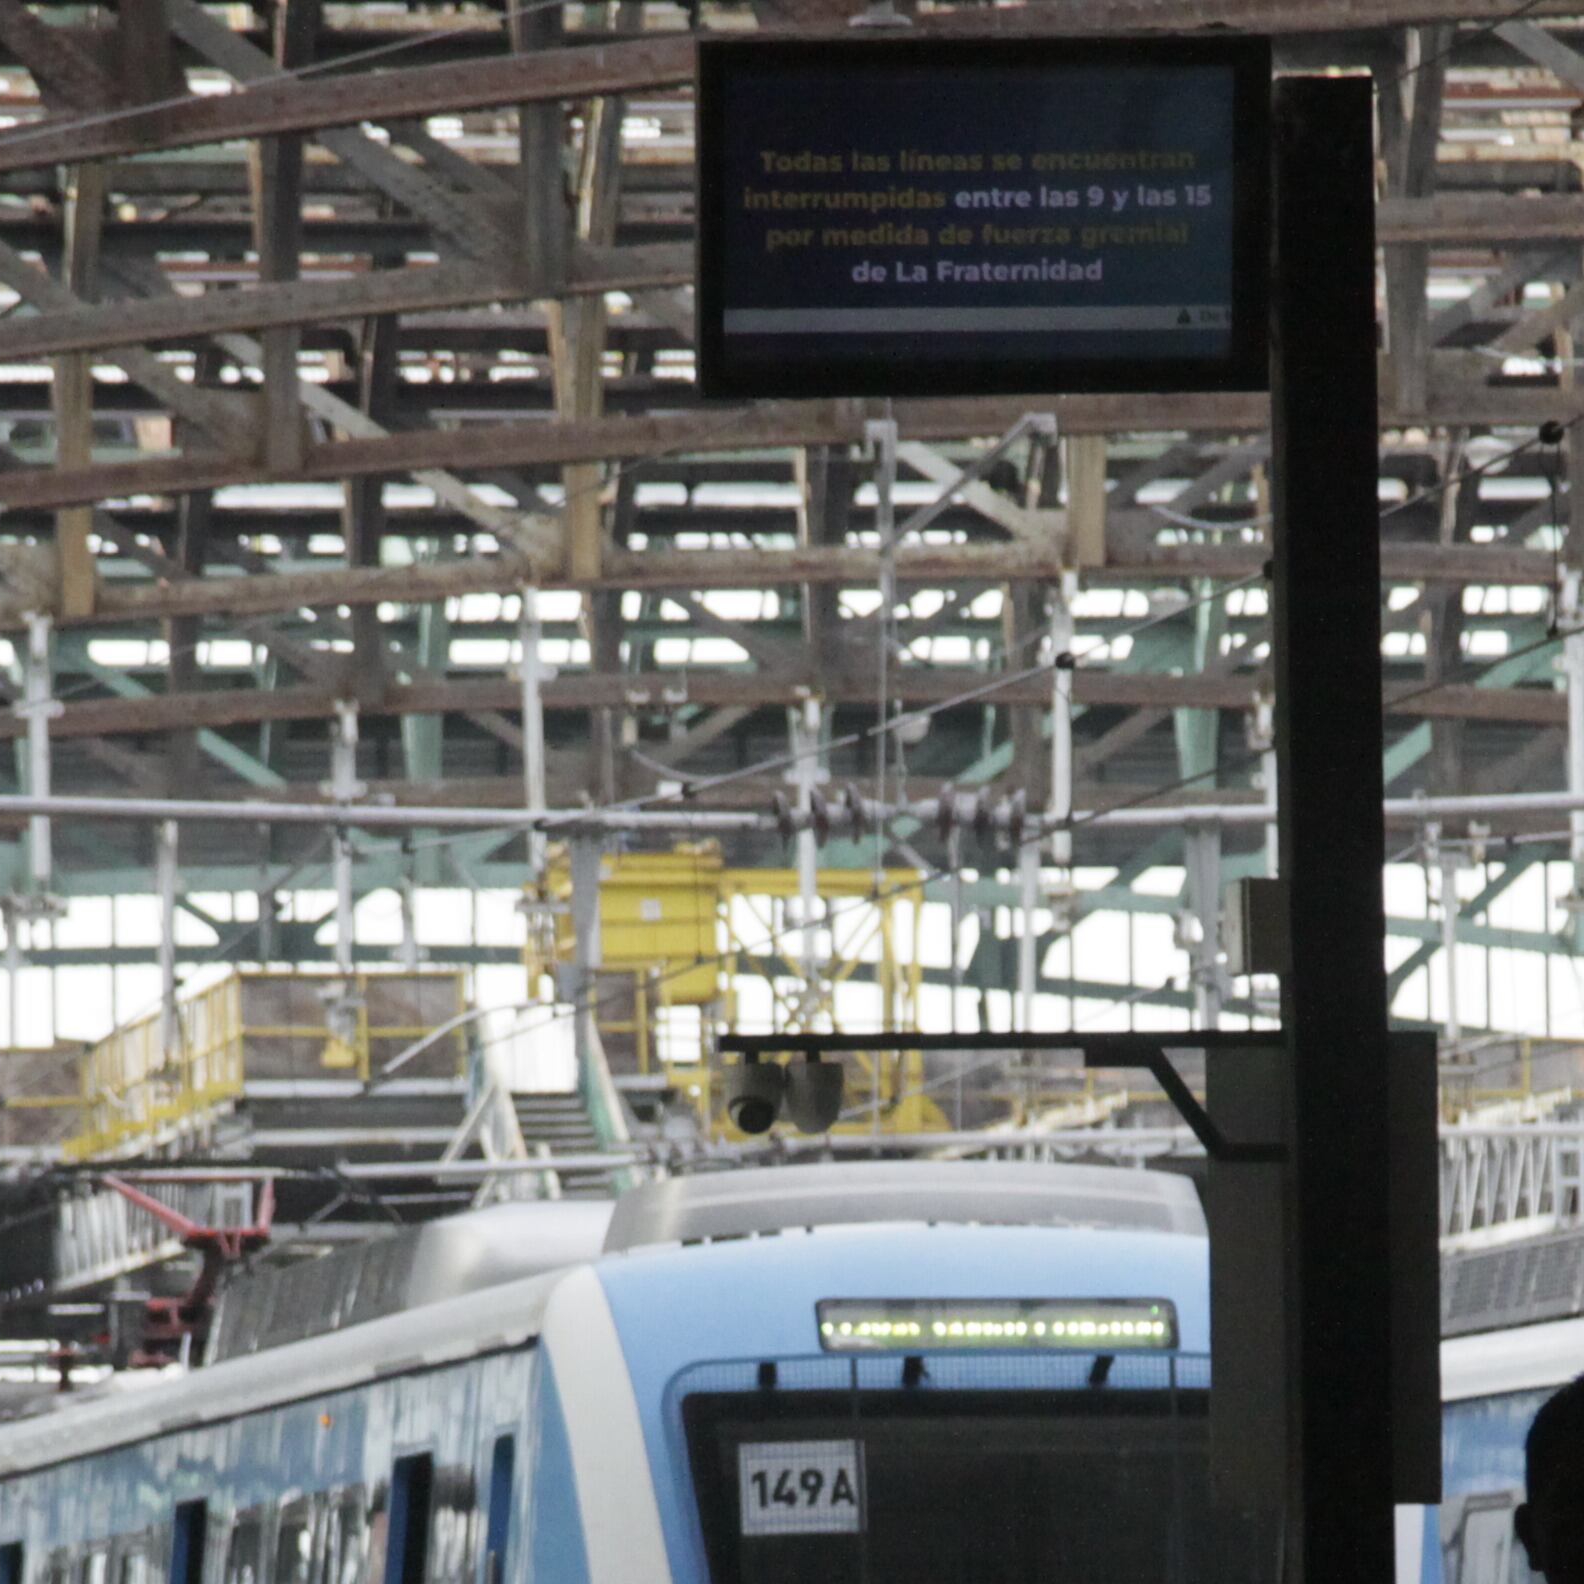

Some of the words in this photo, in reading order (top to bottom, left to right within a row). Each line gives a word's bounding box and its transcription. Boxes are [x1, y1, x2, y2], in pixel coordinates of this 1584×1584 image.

[760, 150, 843, 173] Todas
[851, 149, 891, 173] las
[992, 152, 1023, 172] se
[1032, 150, 1197, 171] encuentran
[743, 185, 947, 214] interrumpidas
[954, 186, 1033, 209] entre
[1040, 183, 1080, 208] las
[1087, 183, 1105, 208] 9
[1112, 189, 1130, 213] y
[1137, 183, 1177, 208] las
[1184, 183, 1213, 207] 15
[766, 227, 815, 253] por
[821, 222, 930, 246] medida
[937, 222, 975, 246] de
[981, 221, 1073, 246] fuerza
[1080, 218, 1190, 250] gremial
[851, 258, 888, 284] de
[895, 259, 929, 283] La
[936, 256, 1104, 284] Fraternidad
[751, 1467, 858, 1509] 149A
